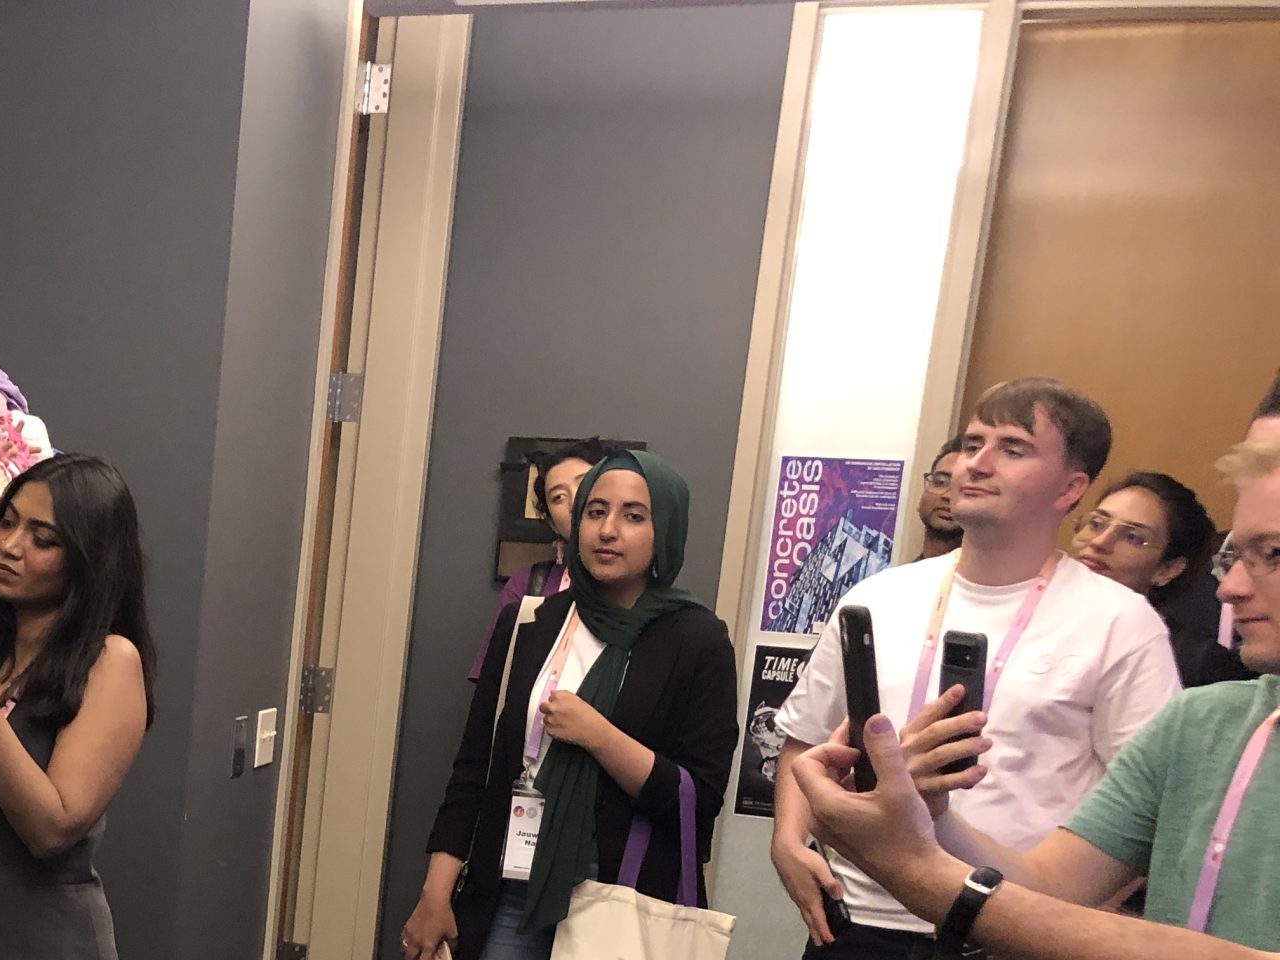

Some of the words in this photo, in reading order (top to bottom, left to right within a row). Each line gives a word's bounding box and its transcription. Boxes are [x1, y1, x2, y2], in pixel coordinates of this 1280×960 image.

[768, 459, 802, 620] concrete
[792, 459, 823, 566] oasis
[761, 670, 795, 682] CAPSULE
[764, 656, 799, 671] TIME
